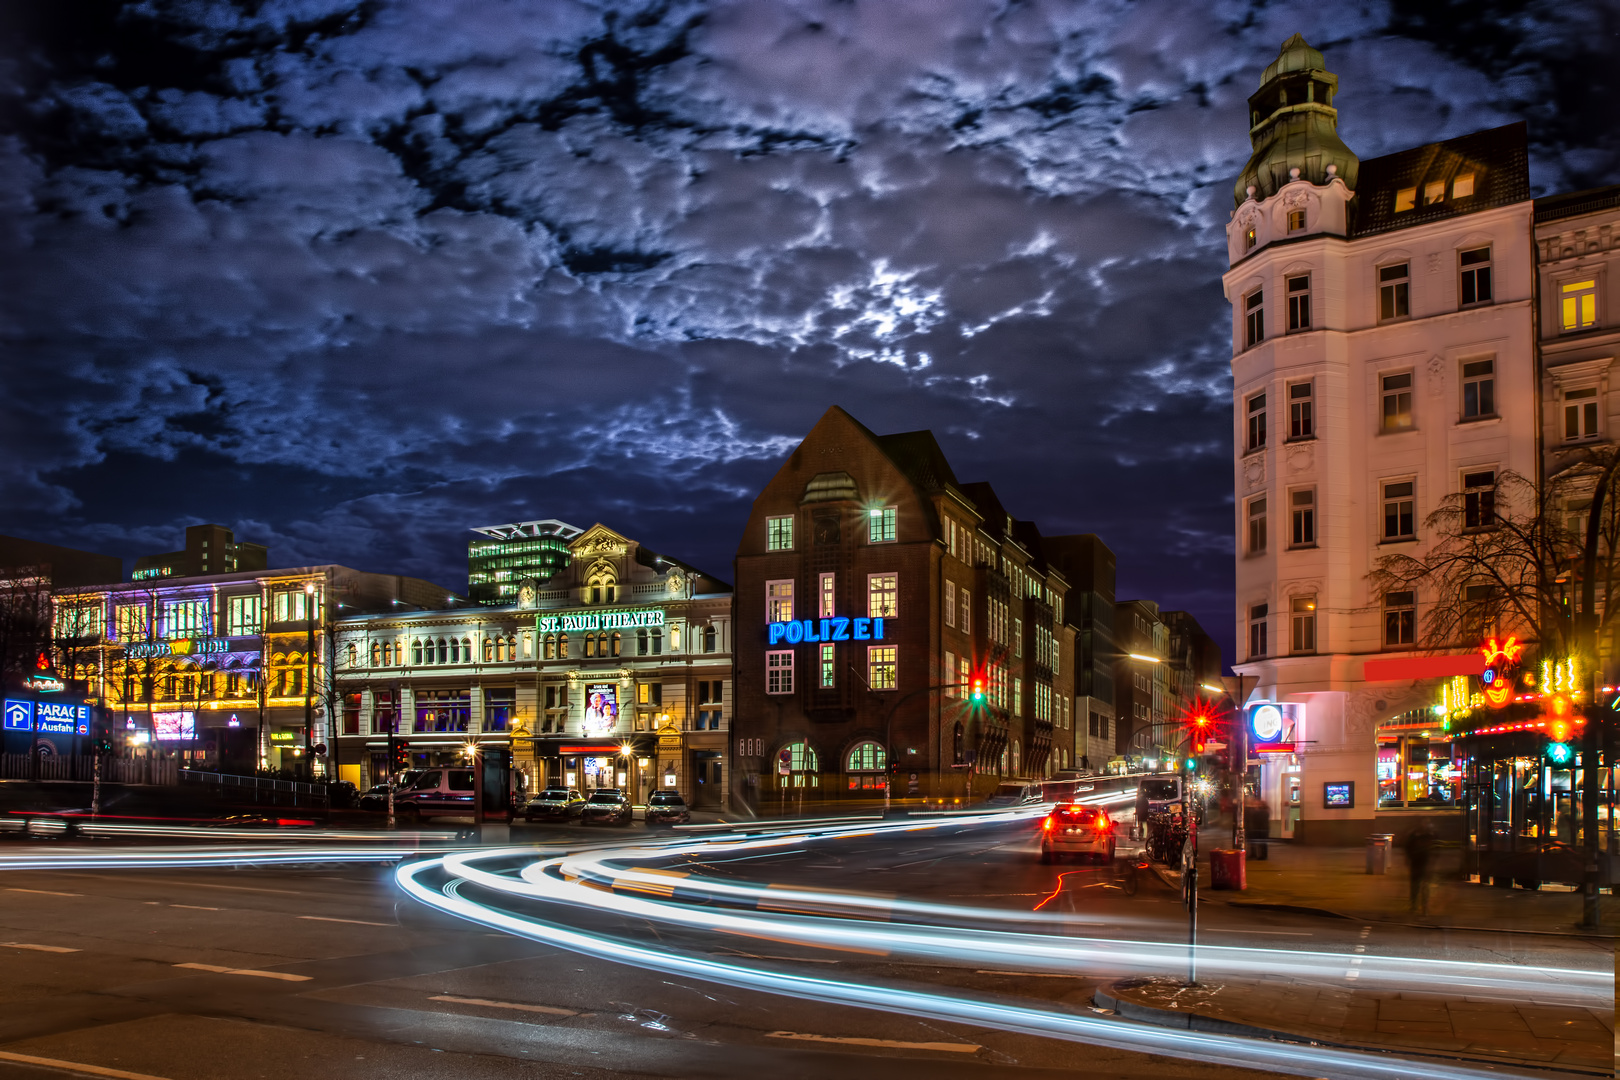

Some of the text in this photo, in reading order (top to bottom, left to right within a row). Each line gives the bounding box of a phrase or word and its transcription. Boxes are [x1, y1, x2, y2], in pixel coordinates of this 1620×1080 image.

[540, 611, 663, 632] ST. PAULI THEATER
[769, 617, 884, 645] POLIZEI
[37, 703, 86, 719] GARAGE
[41, 722, 79, 733] Ausfahr
